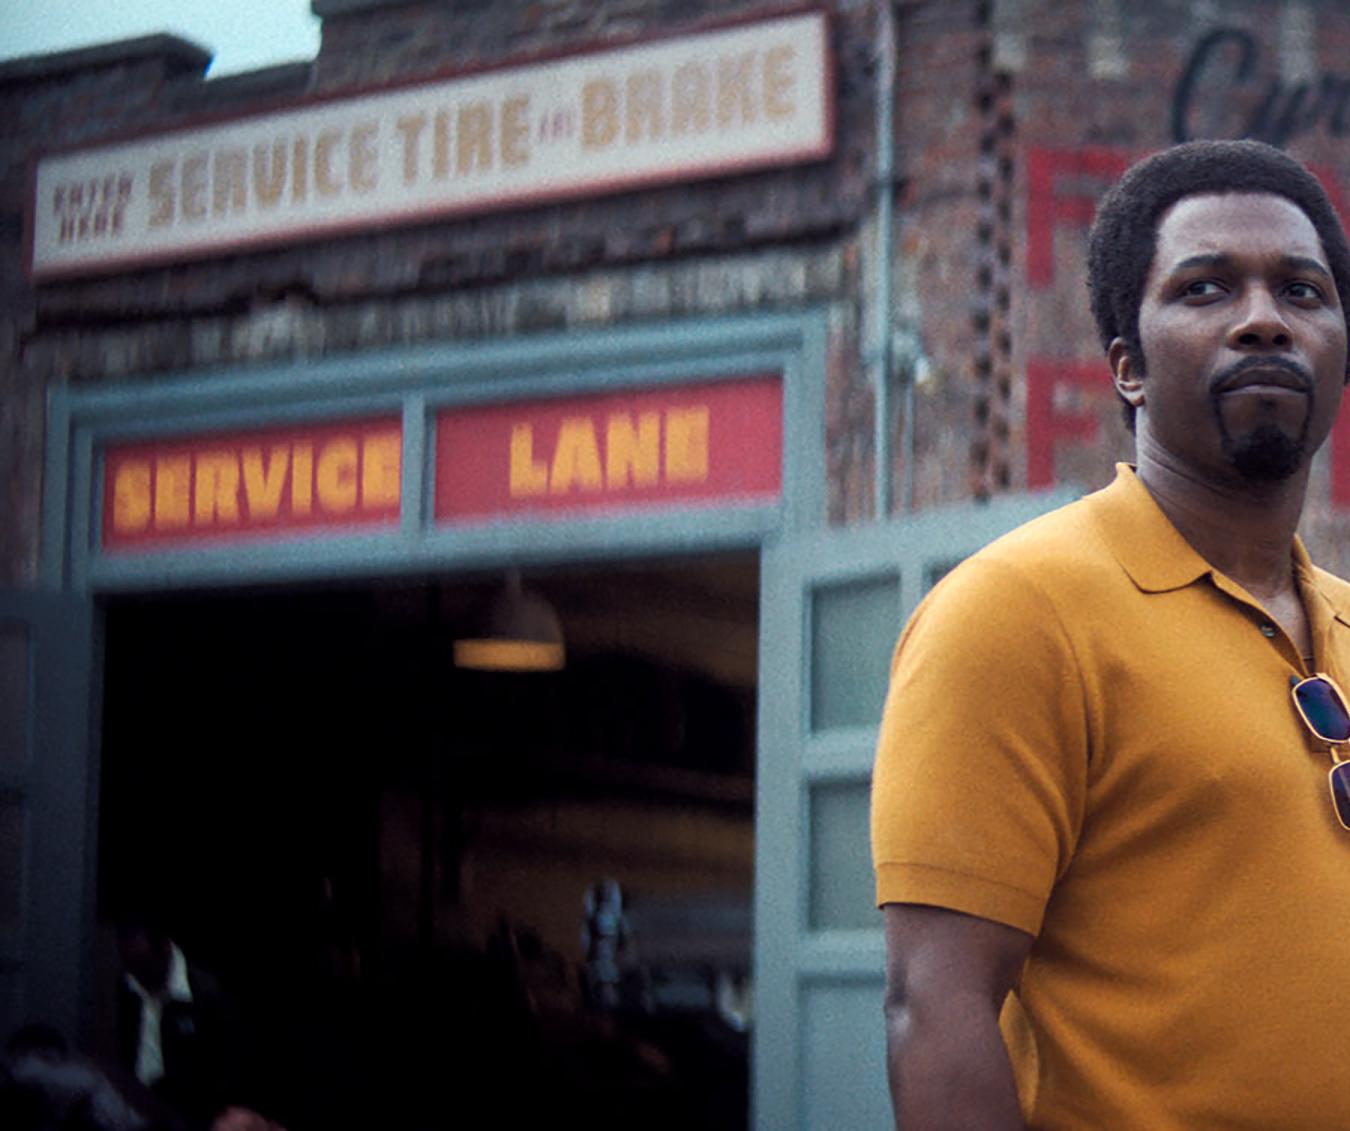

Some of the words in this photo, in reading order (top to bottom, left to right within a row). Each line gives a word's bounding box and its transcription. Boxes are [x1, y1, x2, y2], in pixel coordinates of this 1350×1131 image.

[147, 120, 381, 230] SERVICE
[396, 92, 531, 187] TIRE
[581, 43, 797, 153] BRAKE
[112, 430, 402, 534] SERVICE
[510, 404, 710, 500] LANE
